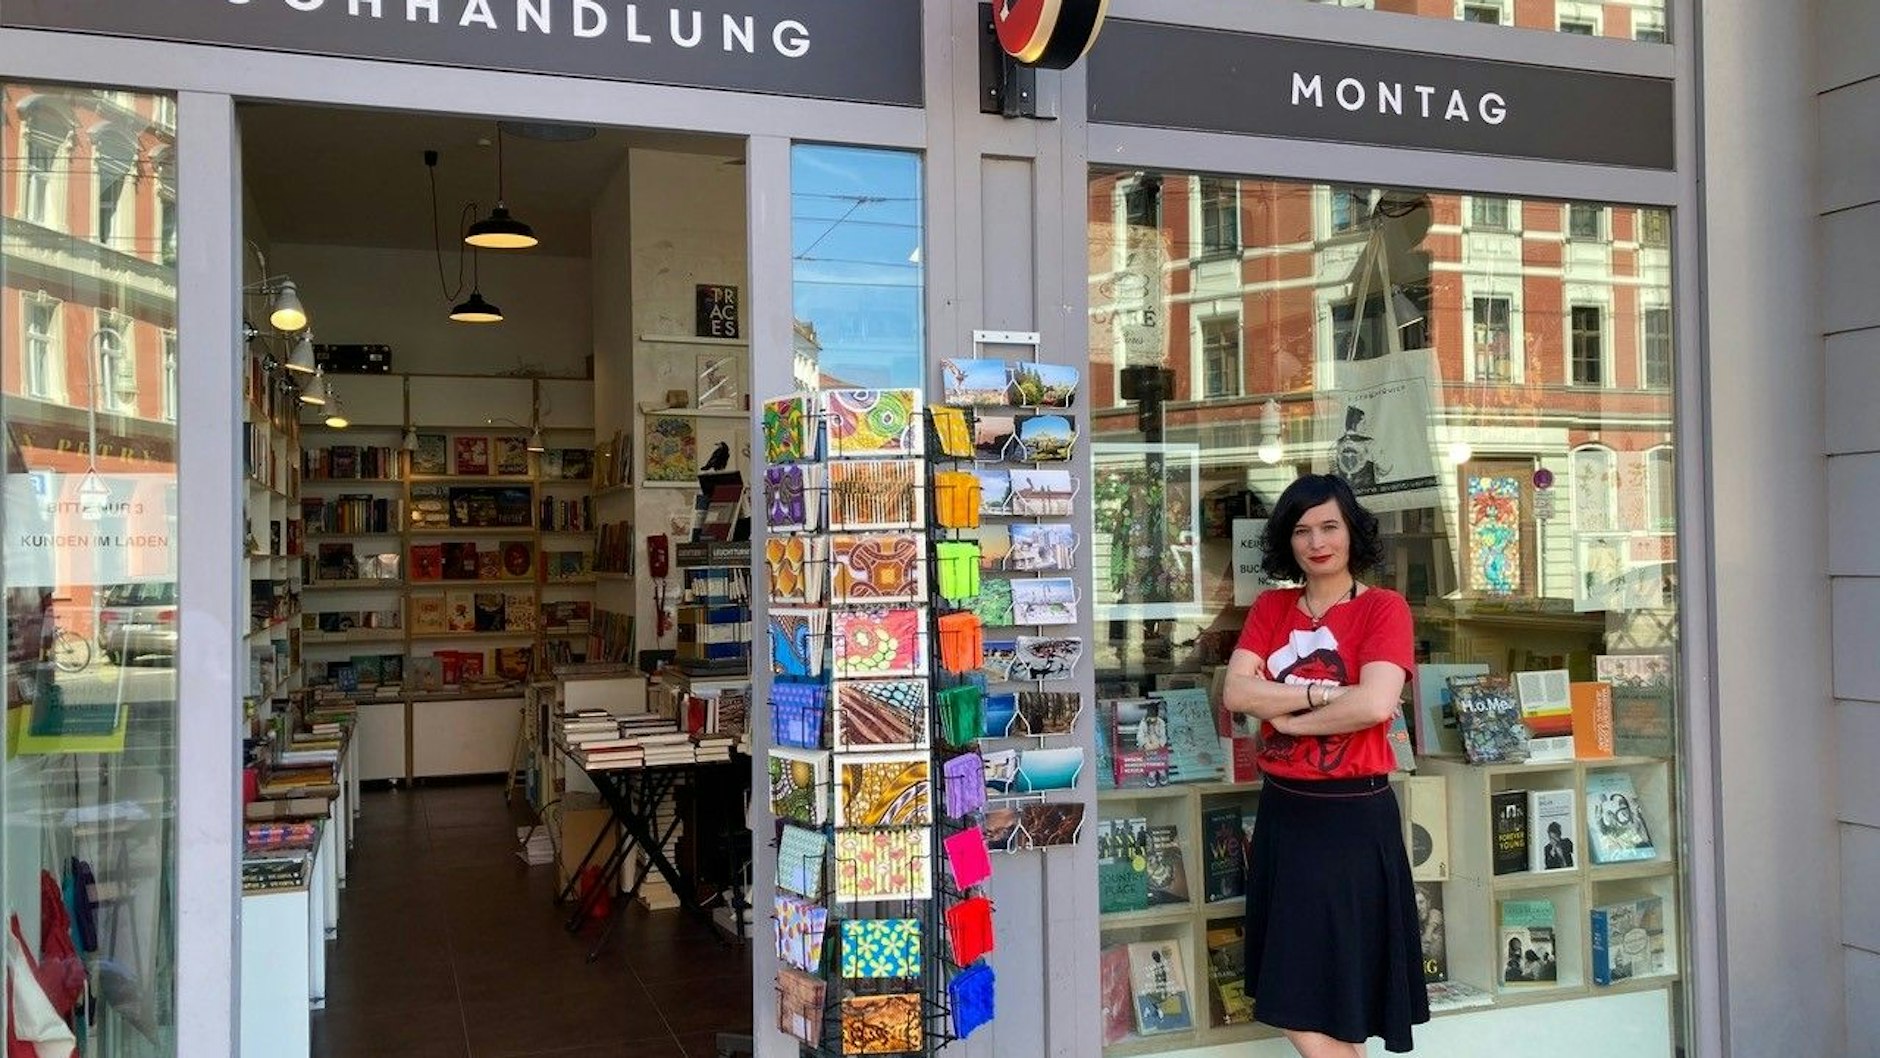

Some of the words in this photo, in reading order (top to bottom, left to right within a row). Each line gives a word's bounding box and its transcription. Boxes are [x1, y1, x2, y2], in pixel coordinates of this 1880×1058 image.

[1290, 72, 1507, 125] MONTAG
[21, 535, 88, 548] KUNDEN
[93, 535, 110, 548] IM
[115, 535, 168, 548] LADEN
